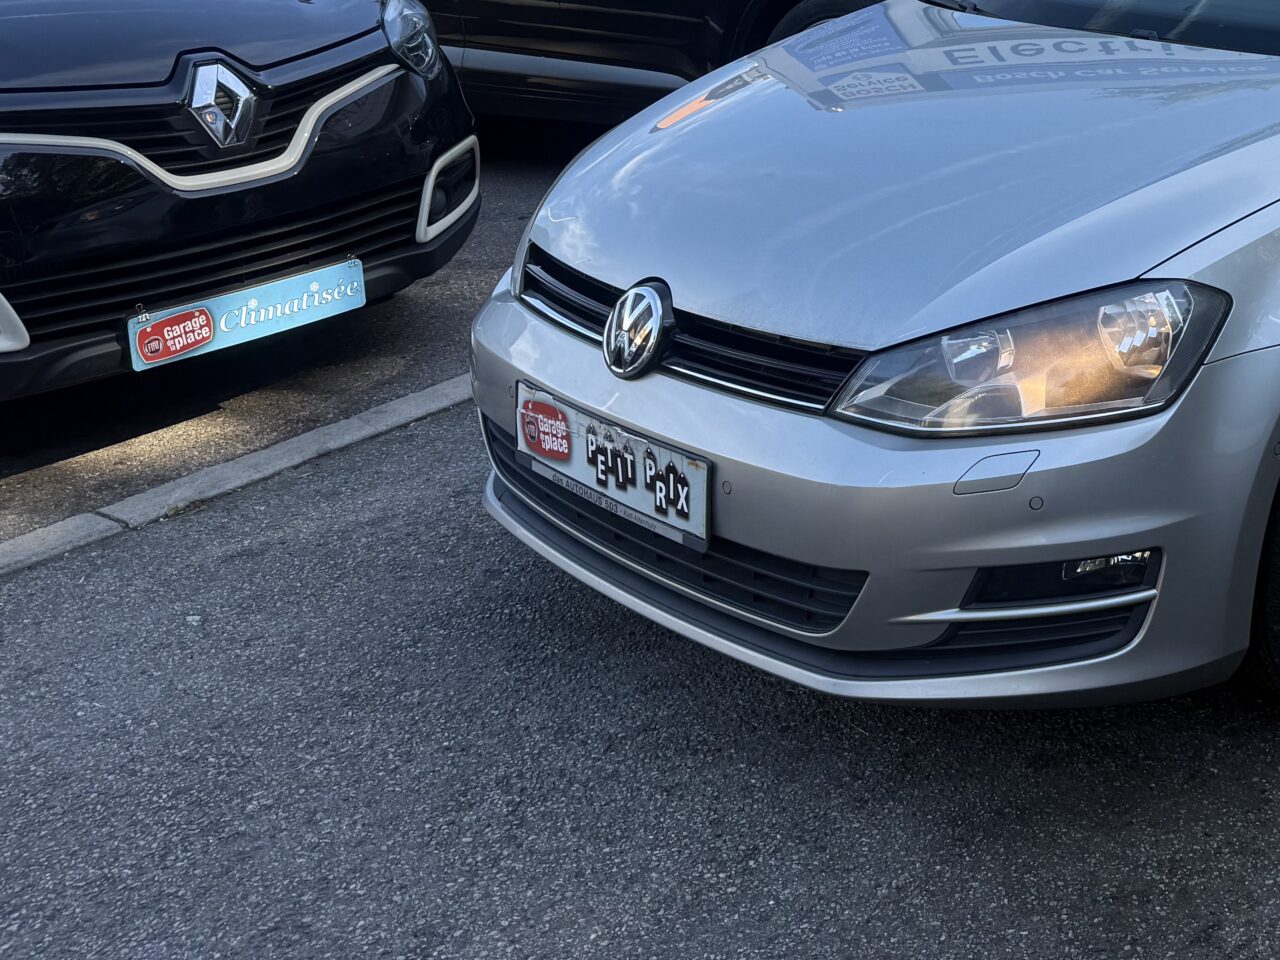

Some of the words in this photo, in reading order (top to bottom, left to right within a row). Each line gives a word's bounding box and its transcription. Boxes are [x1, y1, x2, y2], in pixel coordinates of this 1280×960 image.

[219, 278, 360, 333] Climatisée
[163, 314, 207, 340] Garage
[174, 326, 210, 350] place
[538, 414, 567, 437] Garage
[545, 433, 569, 454] place
[587, 433, 634, 484] PETIT
[646, 458, 690, 514] PRIX
[552, 473, 564, 486] das
[565, 478, 603, 507] AUTOHAUS
[604, 498, 619, 514] 503
